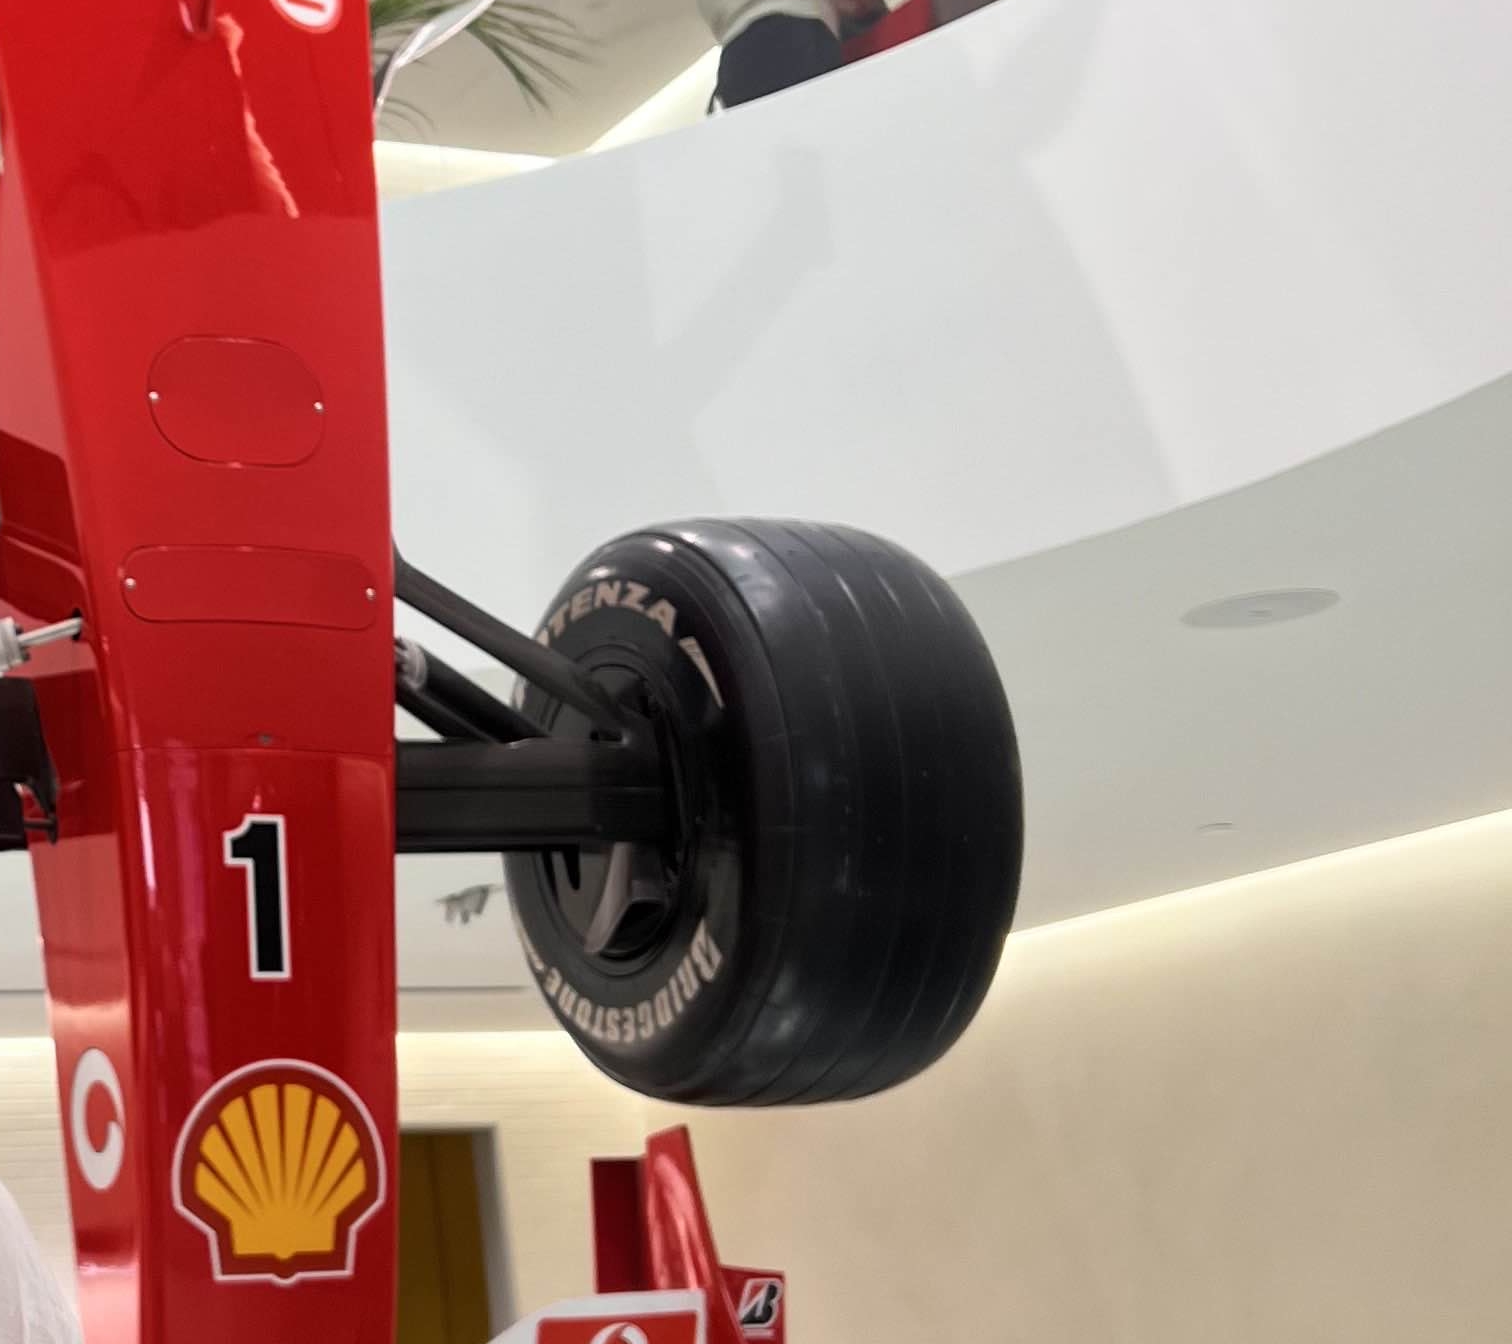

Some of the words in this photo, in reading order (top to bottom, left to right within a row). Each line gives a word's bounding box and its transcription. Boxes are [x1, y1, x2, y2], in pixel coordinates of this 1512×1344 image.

[534, 579, 677, 639] TENZA
[223, 813, 292, 982] 1
[543, 918, 723, 1043] BRIDGESTONE
